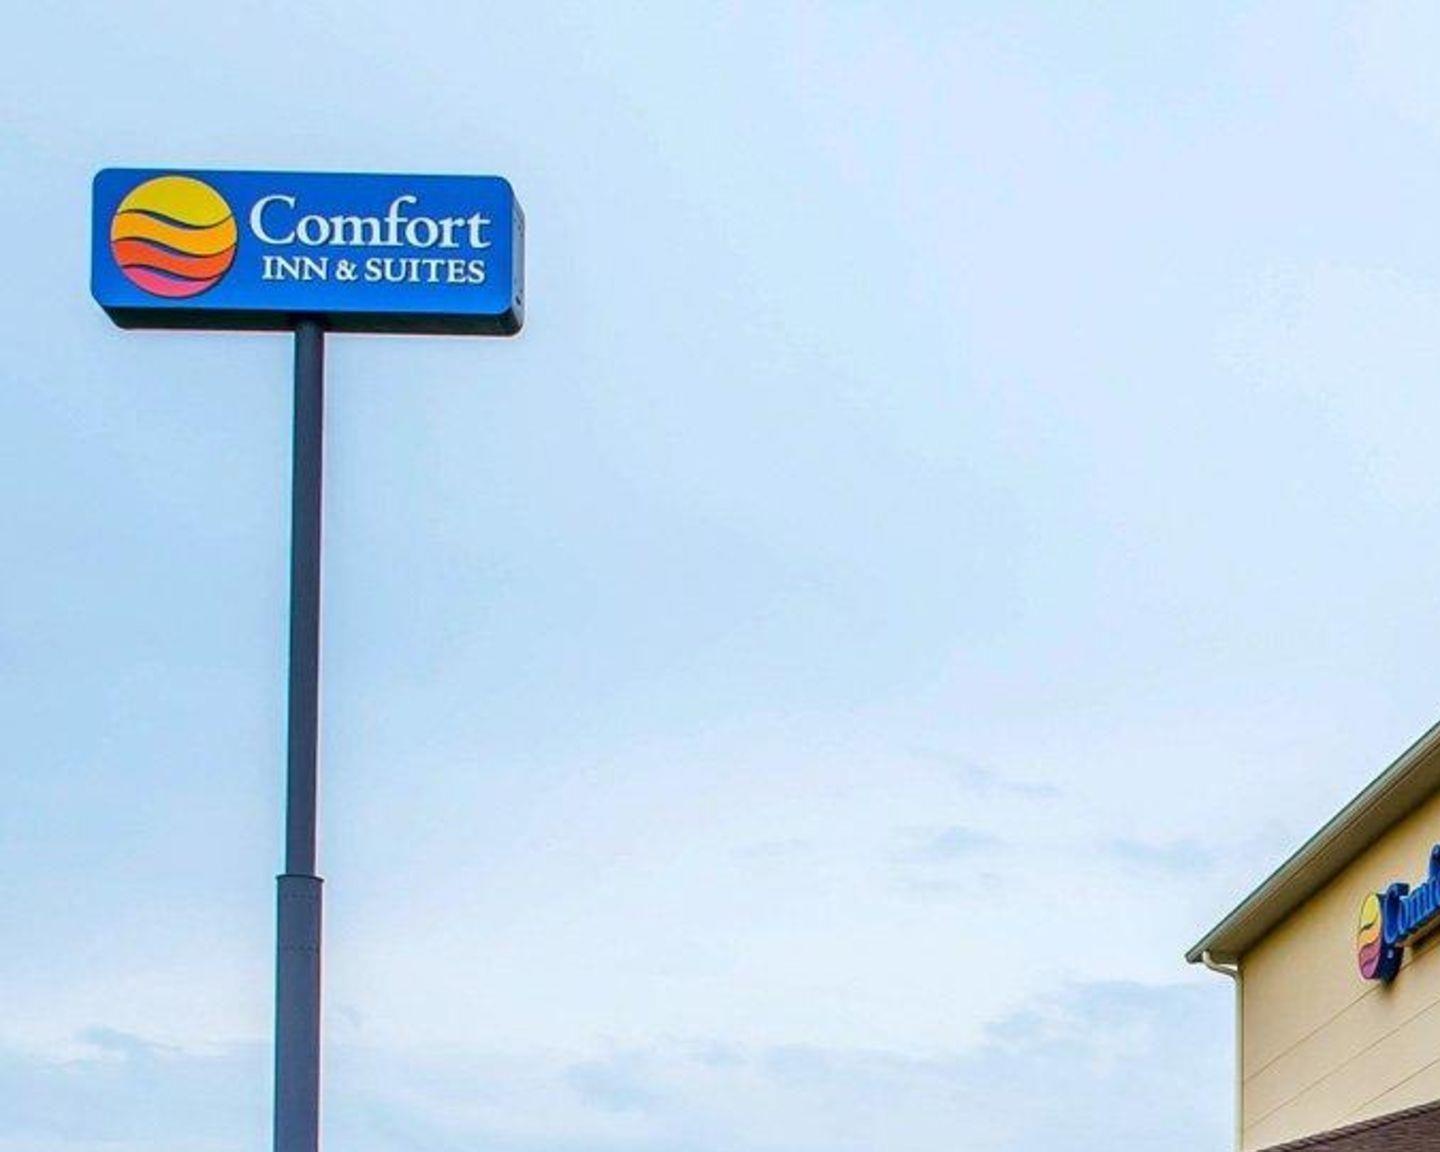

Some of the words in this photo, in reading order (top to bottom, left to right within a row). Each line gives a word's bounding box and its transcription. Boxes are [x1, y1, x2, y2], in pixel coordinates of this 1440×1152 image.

[249, 195, 492, 248] Comfort
[262, 256, 329, 281] INN
[335, 258, 359, 281] &
[361, 256, 485, 284] SUITES
